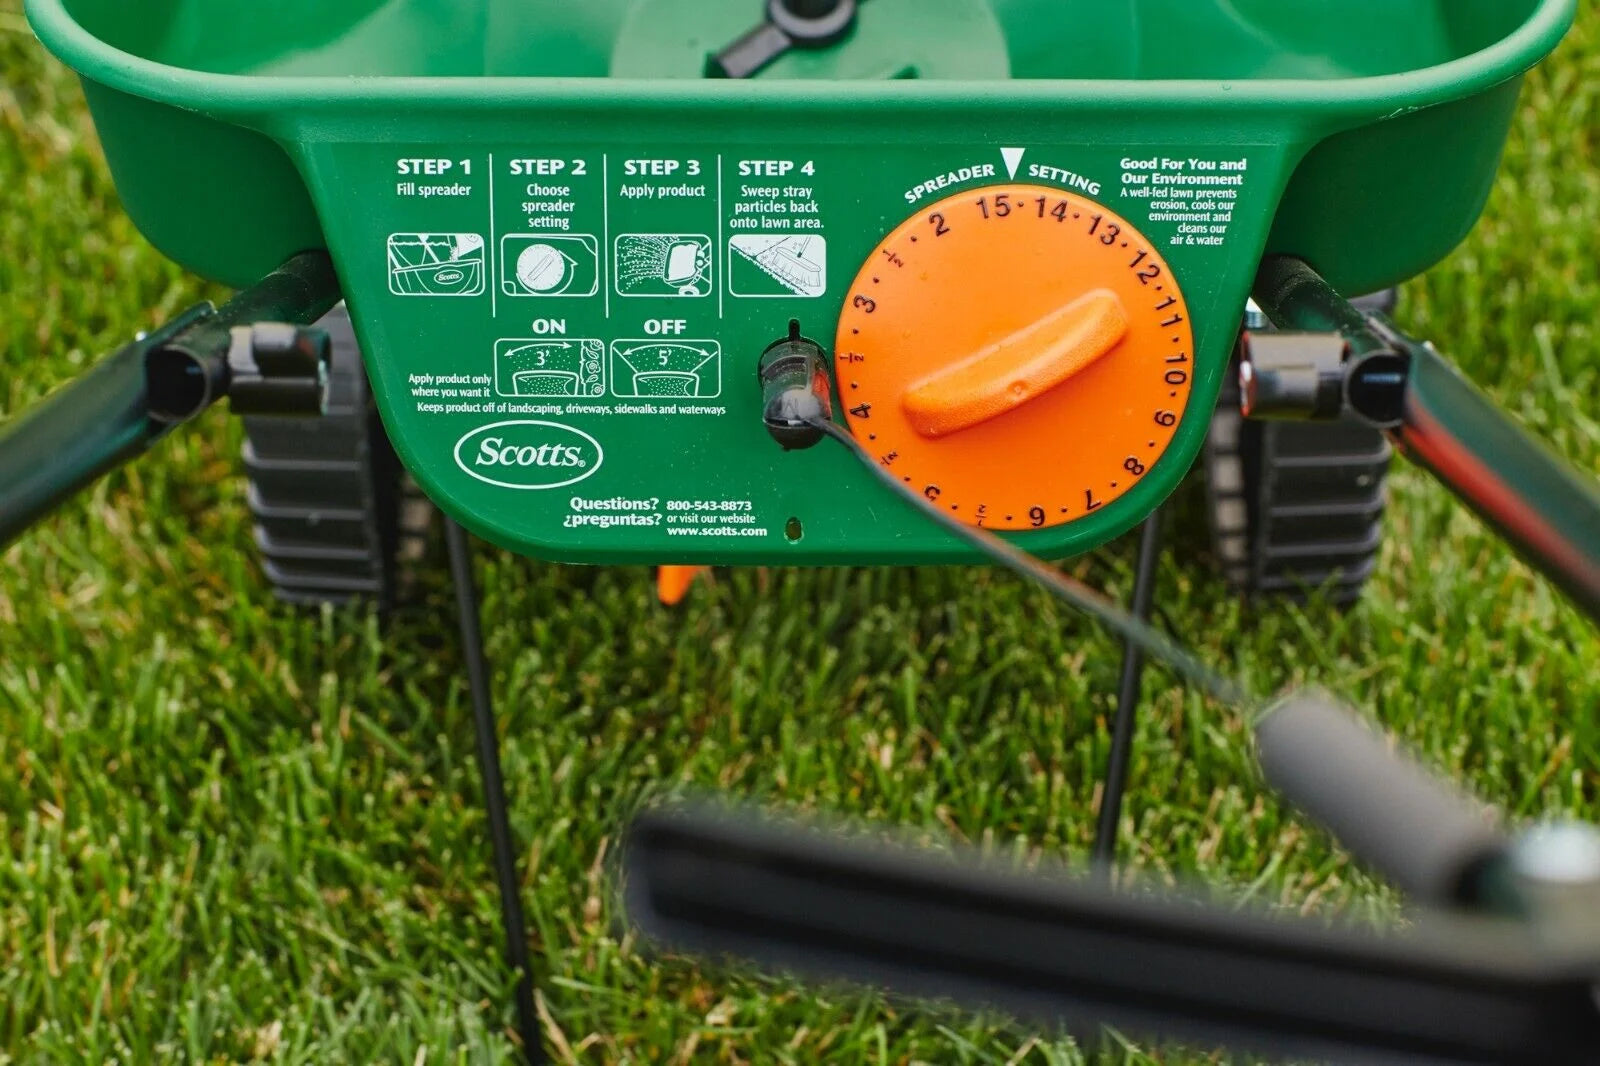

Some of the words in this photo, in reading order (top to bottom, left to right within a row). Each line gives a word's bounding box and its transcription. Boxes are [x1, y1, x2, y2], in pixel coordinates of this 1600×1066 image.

[397, 159, 452, 174] STEP
[460, 159, 470, 174] 1
[510, 159, 565, 174] STEP
[572, 160, 586, 175] 2
[624, 160, 679, 175] STEP
[687, 160, 700, 175] 3
[739, 160, 793, 175] STEP
[801, 161, 815, 175] 4
[1120, 158, 1157, 169] Good
[1162, 159, 1185, 169] For
[1188, 159, 1216, 170] You
[1220, 159, 1246, 170] and
[904, 163, 995, 204] SPREADER
[1028, 163, 1101, 195] SETTING
[1122, 173, 1148, 183] Our
[1152, 172, 1243, 185] Environment
[397, 183, 414, 195] Fill
[418, 183, 471, 198] spreader
[527, 183, 569, 196] Choose
[620, 184, 654, 199] Apply
[658, 184, 706, 199] product
[742, 185, 779, 199] Sweep
[783, 186, 812, 199] stray
[1121, 188, 1127, 197] A
[1130, 187, 1168, 197] well-fed
[1170, 187, 1193, 198] lawn
[1196, 189, 1237, 200] prevents
[522, 199, 574, 214] spreader
[735, 200, 786, 215] particles
[790, 200, 818, 212] back
[976, 195, 1010, 220] 15
[1035, 196, 1069, 221] 14
[1151, 199, 1188, 213] erosion,
[1191, 199, 1216, 209] cools
[1218, 202, 1235, 210] our
[529, 215, 569, 230] setting
[730, 217, 757, 228] onto
[762, 216, 790, 228] lawn
[794, 219, 824, 228] area.
[1149, 211, 1210, 221] environment
[1213, 211, 1231, 221] and
[929, 213, 950, 237] 2
[1089, 215, 1121, 246] 13
[1178, 223, 1207, 233] cleans
[1186, 235, 1194, 244] &
[1196, 236, 1224, 245] water
[1128, 249, 1161, 285] 12
[853, 294, 877, 314] 3
[1154, 296, 1183, 327] 11
[533, 319, 565, 334] ON
[644, 319, 686, 334] OFF
[1164, 351, 1188, 386] 10
[409, 373, 434, 385] Apply
[436, 374, 470, 385] product
[472, 374, 491, 386] only
[412, 386, 439, 396] where
[441, 389, 457, 398] you
[459, 388, 482, 397] want
[484, 387, 490, 397] it
[417, 402, 444, 413] Keeps
[446, 402, 480, 413] product
[483, 403, 495, 412] off
[497, 403, 506, 412] of
[508, 403, 563, 415] landscaping,
[566, 404, 612, 415] driveways,
[614, 404, 657, 413] sidewalks
[659, 404, 676, 414] and
[679, 406, 725, 416] waterways
[849, 402, 871, 419] 4
[1154, 411, 1176, 427] 9
[1123, 456, 1145, 476] 8
[570, 497, 659, 512] Questions?
[667, 501, 752, 511] 800-543-8873
[1084, 488, 1101, 510] 7
[564, 513, 662, 528] ¿preguntas?
[679, 513, 698, 523] visit
[720, 513, 755, 523] website
[1029, 505, 1046, 527] 6
[667, 527, 767, 536] www.scotts.com
